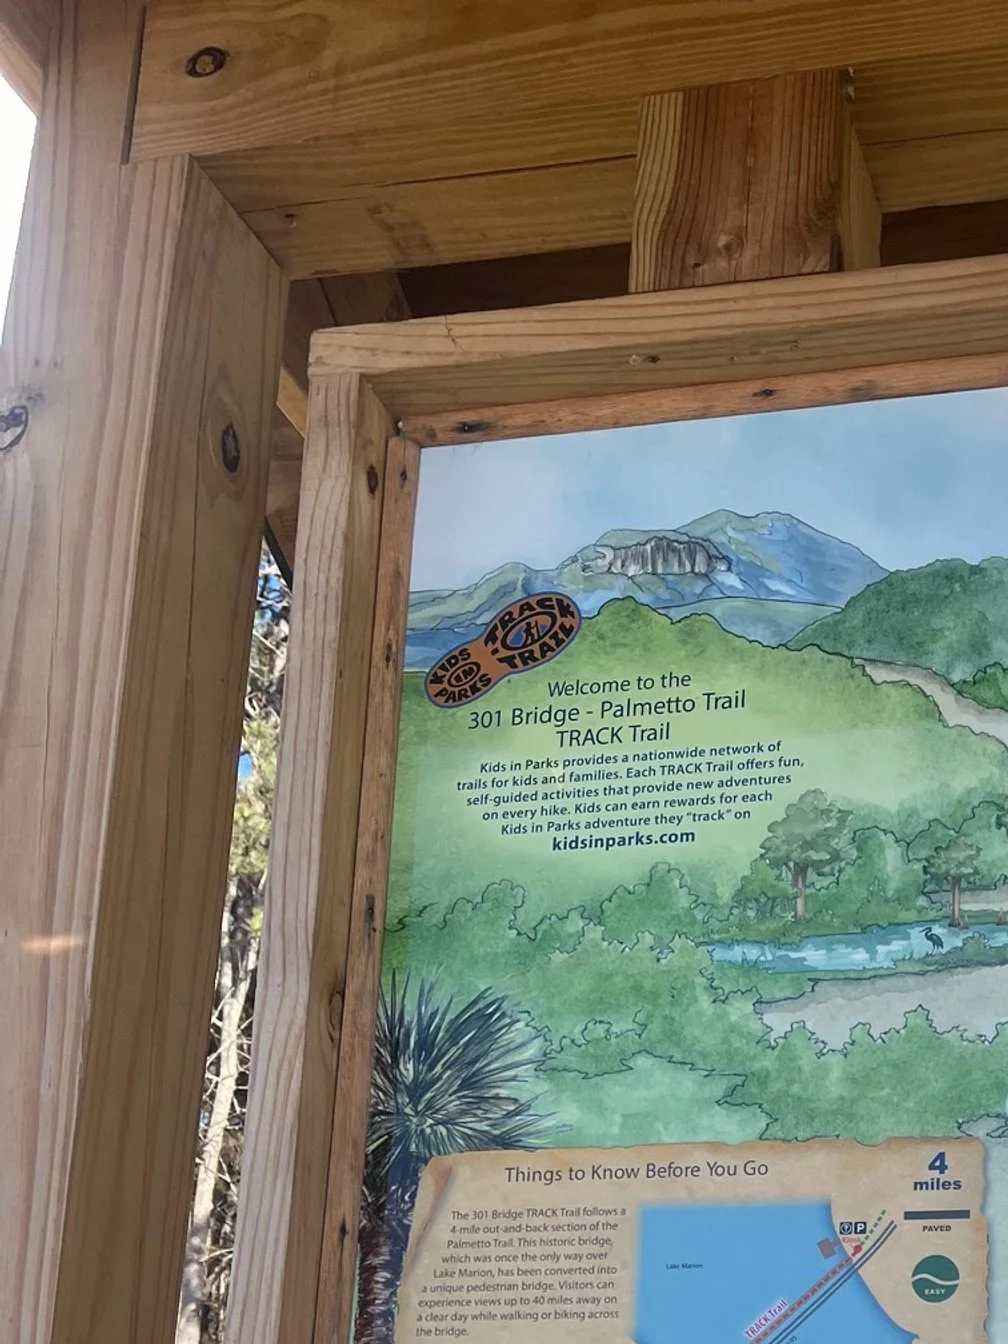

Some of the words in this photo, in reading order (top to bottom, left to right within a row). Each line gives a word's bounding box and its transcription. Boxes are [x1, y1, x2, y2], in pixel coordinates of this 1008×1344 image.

[484, 597, 576, 647] TRACK
[497, 622, 574, 669] TRAIL
[430, 648, 471, 685] KIDS
[453, 666, 474, 683] IN
[434, 673, 492, 703] PARKS
[547, 679, 630, 696] Welcome
[636, 676, 654, 690] to
[660, 672, 691, 688] the
[468, 710, 501, 729] 301
[511, 705, 579, 727] Bridge
[600, 697, 695, 718] Palmetto
[701, 690, 745, 710] Trail
[556, 726, 622, 746] TRACK
[628, 722, 669, 741] Trail
[480, 761, 506, 773] Kids
[510, 760, 521, 771] in
[525, 757, 558, 769] Parks
[562, 753, 618, 769] provides
[621, 754, 628, 762] a
[632, 746, 705, 761] nationwide
[709, 742, 763, 755] network
[767, 739, 781, 752] of
[456, 778, 487, 790] trails
[491, 776, 509, 788] for
[512, 774, 538, 786] kids
[541, 772, 565, 784] and
[569, 769, 622, 782] families.
[626, 765, 656, 778] Each
[659, 762, 702, 775] TRACK
[705, 760, 733, 772] Trail
[736, 758, 774, 770] offers
[778, 756, 803, 767] fun,
[466, 790, 538, 806] self-guided
[541, 787, 599, 800] activities
[602, 784, 629, 795] that
[632, 780, 682, 796] provide
[686, 780, 713, 789] new
[717, 775, 791, 787] adventures
[482, 811, 498, 820] on
[501, 809, 537, 819] every
[540, 804, 570, 816] hike.
[574, 802, 601, 813] Kids
[604, 802, 627, 812] can
[630, 800, 659, 810] earn
[663, 794, 715, 807] rewards
[719, 792, 738, 803] for
[741, 790, 772, 802] each
[501, 823, 527, 834] Kids
[531, 822, 542, 832] in
[546, 819, 581, 831] Parks
[584, 817, 650, 829] adventure
[654, 813, 683, 826] they
[734, 810, 750, 819] on
[552, 831, 695, 850] kidsinparks.com
[504, 1166, 562, 1185] Things
[568, 1166, 585, 1180] to
[591, 1164, 640, 1179] Know
[646, 1162, 700, 1178] Before
[706, 1161, 737, 1176] You
[743, 1160, 768, 1175] Go
[928, 1152, 948, 1174] 4
[913, 1178, 962, 1191] miles
[451, 1210, 469, 1220] The
[471, 1210, 488, 1219] 301
[491, 1209, 524, 1220] Bridge
[525, 1207, 558, 1218] TRACK
[560, 1207, 580, 1217] Trail
[582, 1206, 618, 1216] follows
[620, 1207, 626, 1215] a
[449, 1224, 481, 1234] 4-mile
[482, 1222, 549, 1233] out-and-back
[550, 1223, 586, 1231] section
[588, 1220, 600, 1231] of
[601, 1220, 618, 1230] the
[745, 1316, 770, 1338] TRACK
[768, 1300, 787, 1317] Trail
